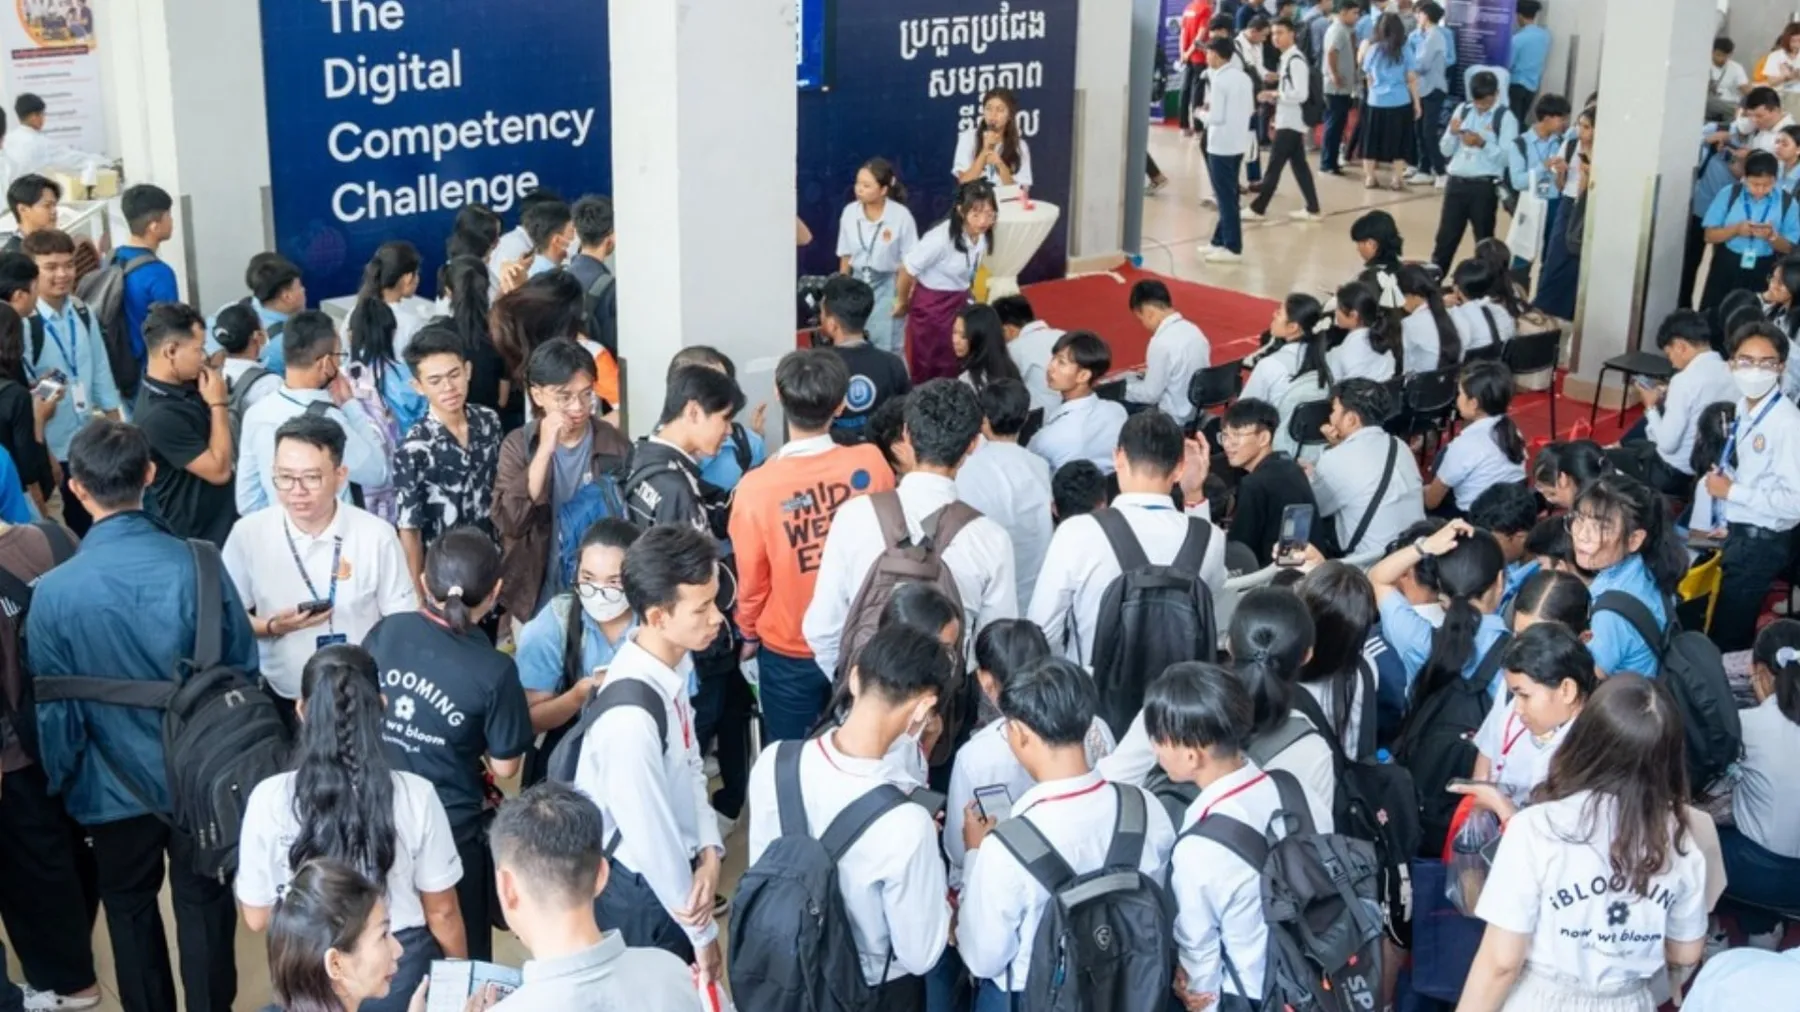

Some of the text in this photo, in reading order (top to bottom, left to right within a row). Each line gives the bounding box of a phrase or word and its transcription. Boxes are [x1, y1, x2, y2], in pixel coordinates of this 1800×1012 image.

[321, 0, 405, 33] The
[324, 48, 462, 105] Digital
[327, 107, 595, 163] Competency
[331, 170, 540, 223] Challenge
[782, 511, 838, 549] WE
[797, 543, 823, 575] E
[378, 668, 466, 727] LOOMING
[404, 723, 447, 747] bloom
[1549, 874, 1677, 911] iBLOOIN
[1560, 927, 1593, 939] now
[1620, 929, 1662, 943] bloom
